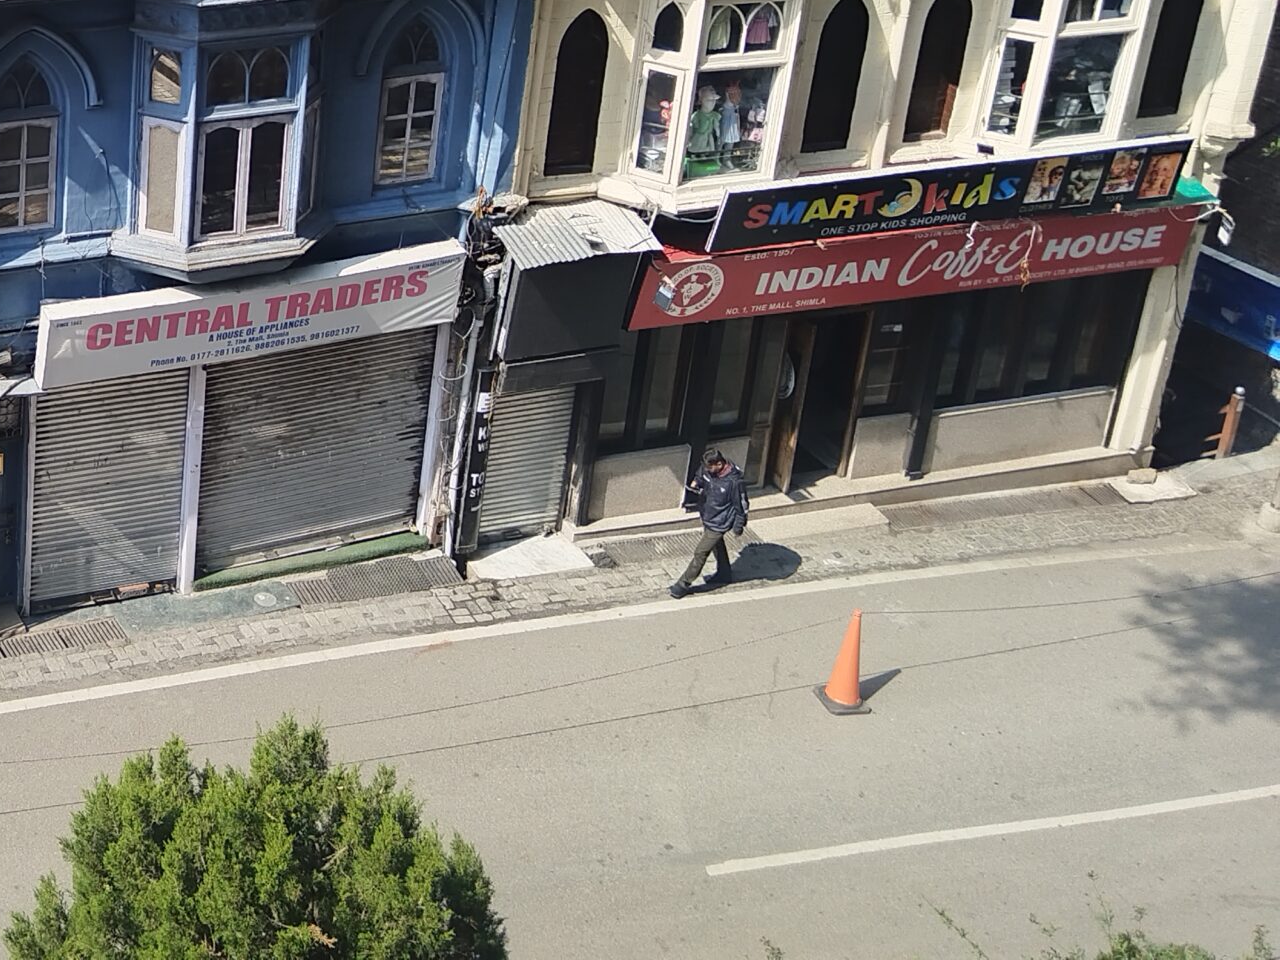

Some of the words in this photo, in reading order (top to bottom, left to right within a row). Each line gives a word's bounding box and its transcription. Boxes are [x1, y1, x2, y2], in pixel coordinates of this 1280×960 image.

[743, 189, 884, 230] SMART
[922, 171, 1022, 215] kids
[820, 225, 845, 237] ONE
[846, 221, 879, 233] STOP
[880, 218, 908, 229] KIDS
[909, 212, 967, 227] SHOPPING
[754, 257, 891, 296] INDIAN
[1041, 224, 1167, 261] HOUSE
[86, 302, 254, 351] CENTRAL
[264, 270, 429, 323] TRADERS
[725, 307, 740, 316] NO.
[751, 304, 768, 312] THE
[795, 297, 826, 308] SHIMLA
[208, 334, 214, 342] A
[216, 330, 244, 341] HOUSE
[246, 328, 257, 337] OF
[258, 318, 310, 334] APPLIANCES
[235, 338, 247, 346] The
[150, 356, 175, 367] Phone
[176, 355, 188, 364] No.
